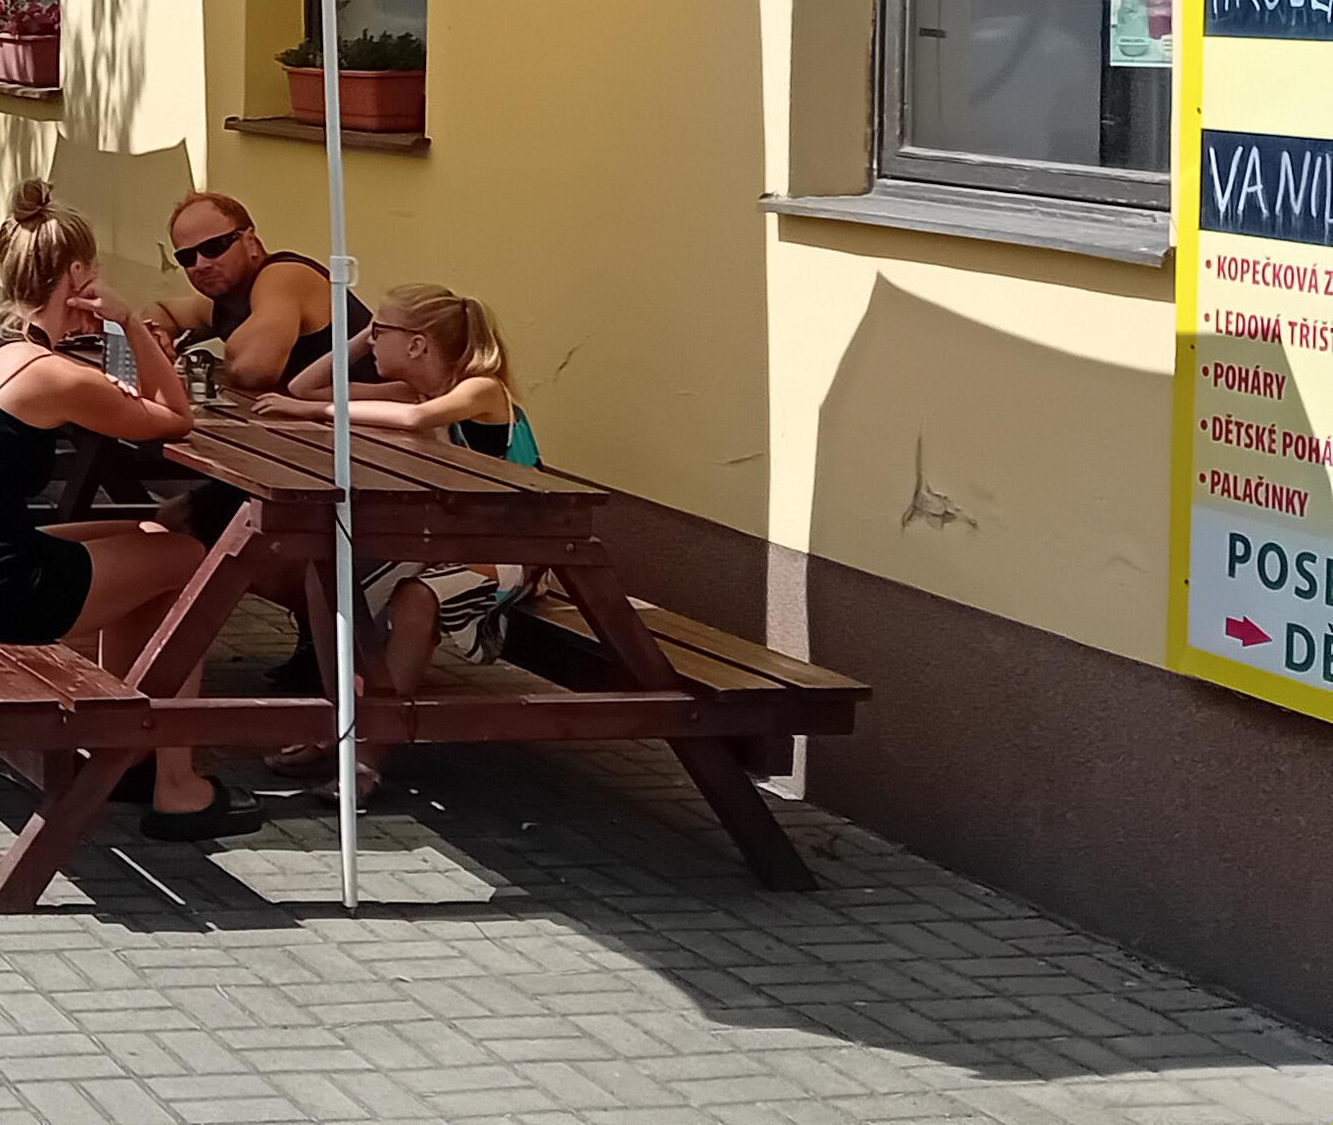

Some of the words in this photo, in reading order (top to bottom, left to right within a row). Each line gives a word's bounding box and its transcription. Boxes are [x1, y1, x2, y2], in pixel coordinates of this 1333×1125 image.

[1217, 255, 1320, 295] KOPEČKOVÁ
[1215, 309, 1283, 344] LEDOVÁ
[1212, 361, 1287, 401] POHÁRY
[1211, 413, 1277, 455] DĚTSKÉ
[1210, 470, 1309, 518] PALAČINKY
